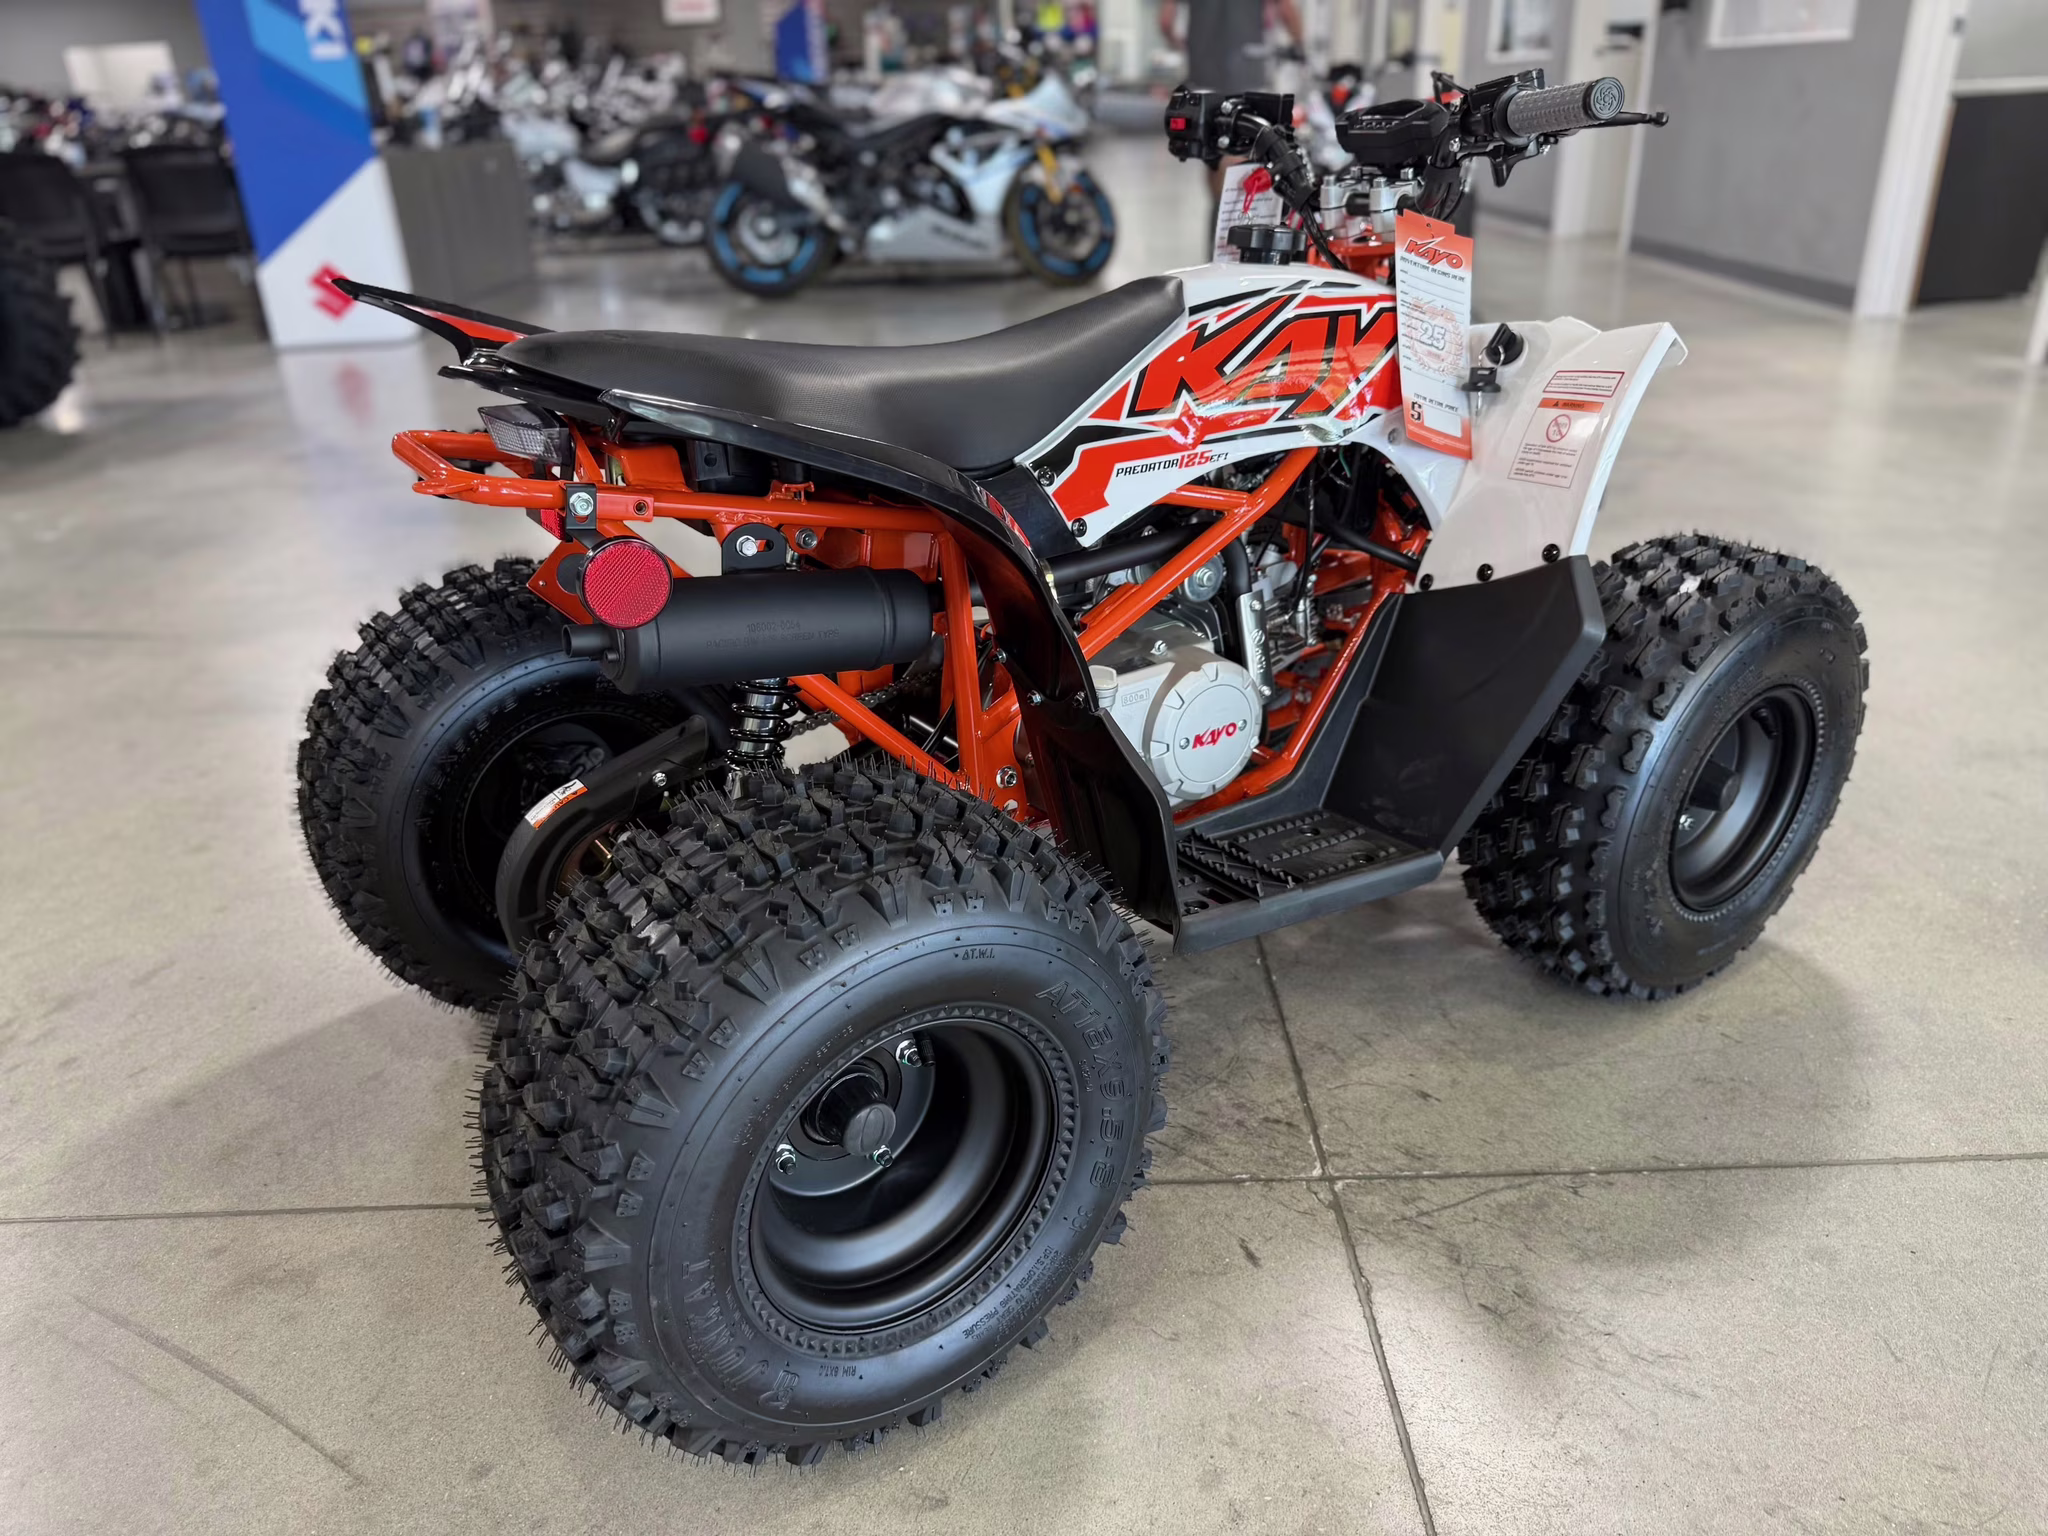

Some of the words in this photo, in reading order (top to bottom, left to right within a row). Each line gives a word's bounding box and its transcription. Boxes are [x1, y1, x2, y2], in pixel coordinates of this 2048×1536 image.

[1404, 237, 1464, 269] KAYO
[1419, 320, 1447, 351] 25
[1129, 293, 1397, 419] KAY
[1410, 401, 1422, 421] $
[1115, 458, 1179, 478] PREDATOR
[1178, 450, 1213, 470] 125
[1210, 452, 1229, 463] EFI
[1192, 722, 1237, 750] KAYO
[961, 1306, 999, 1339] PRESSURE
[841, 1365, 857, 1377] RIM
